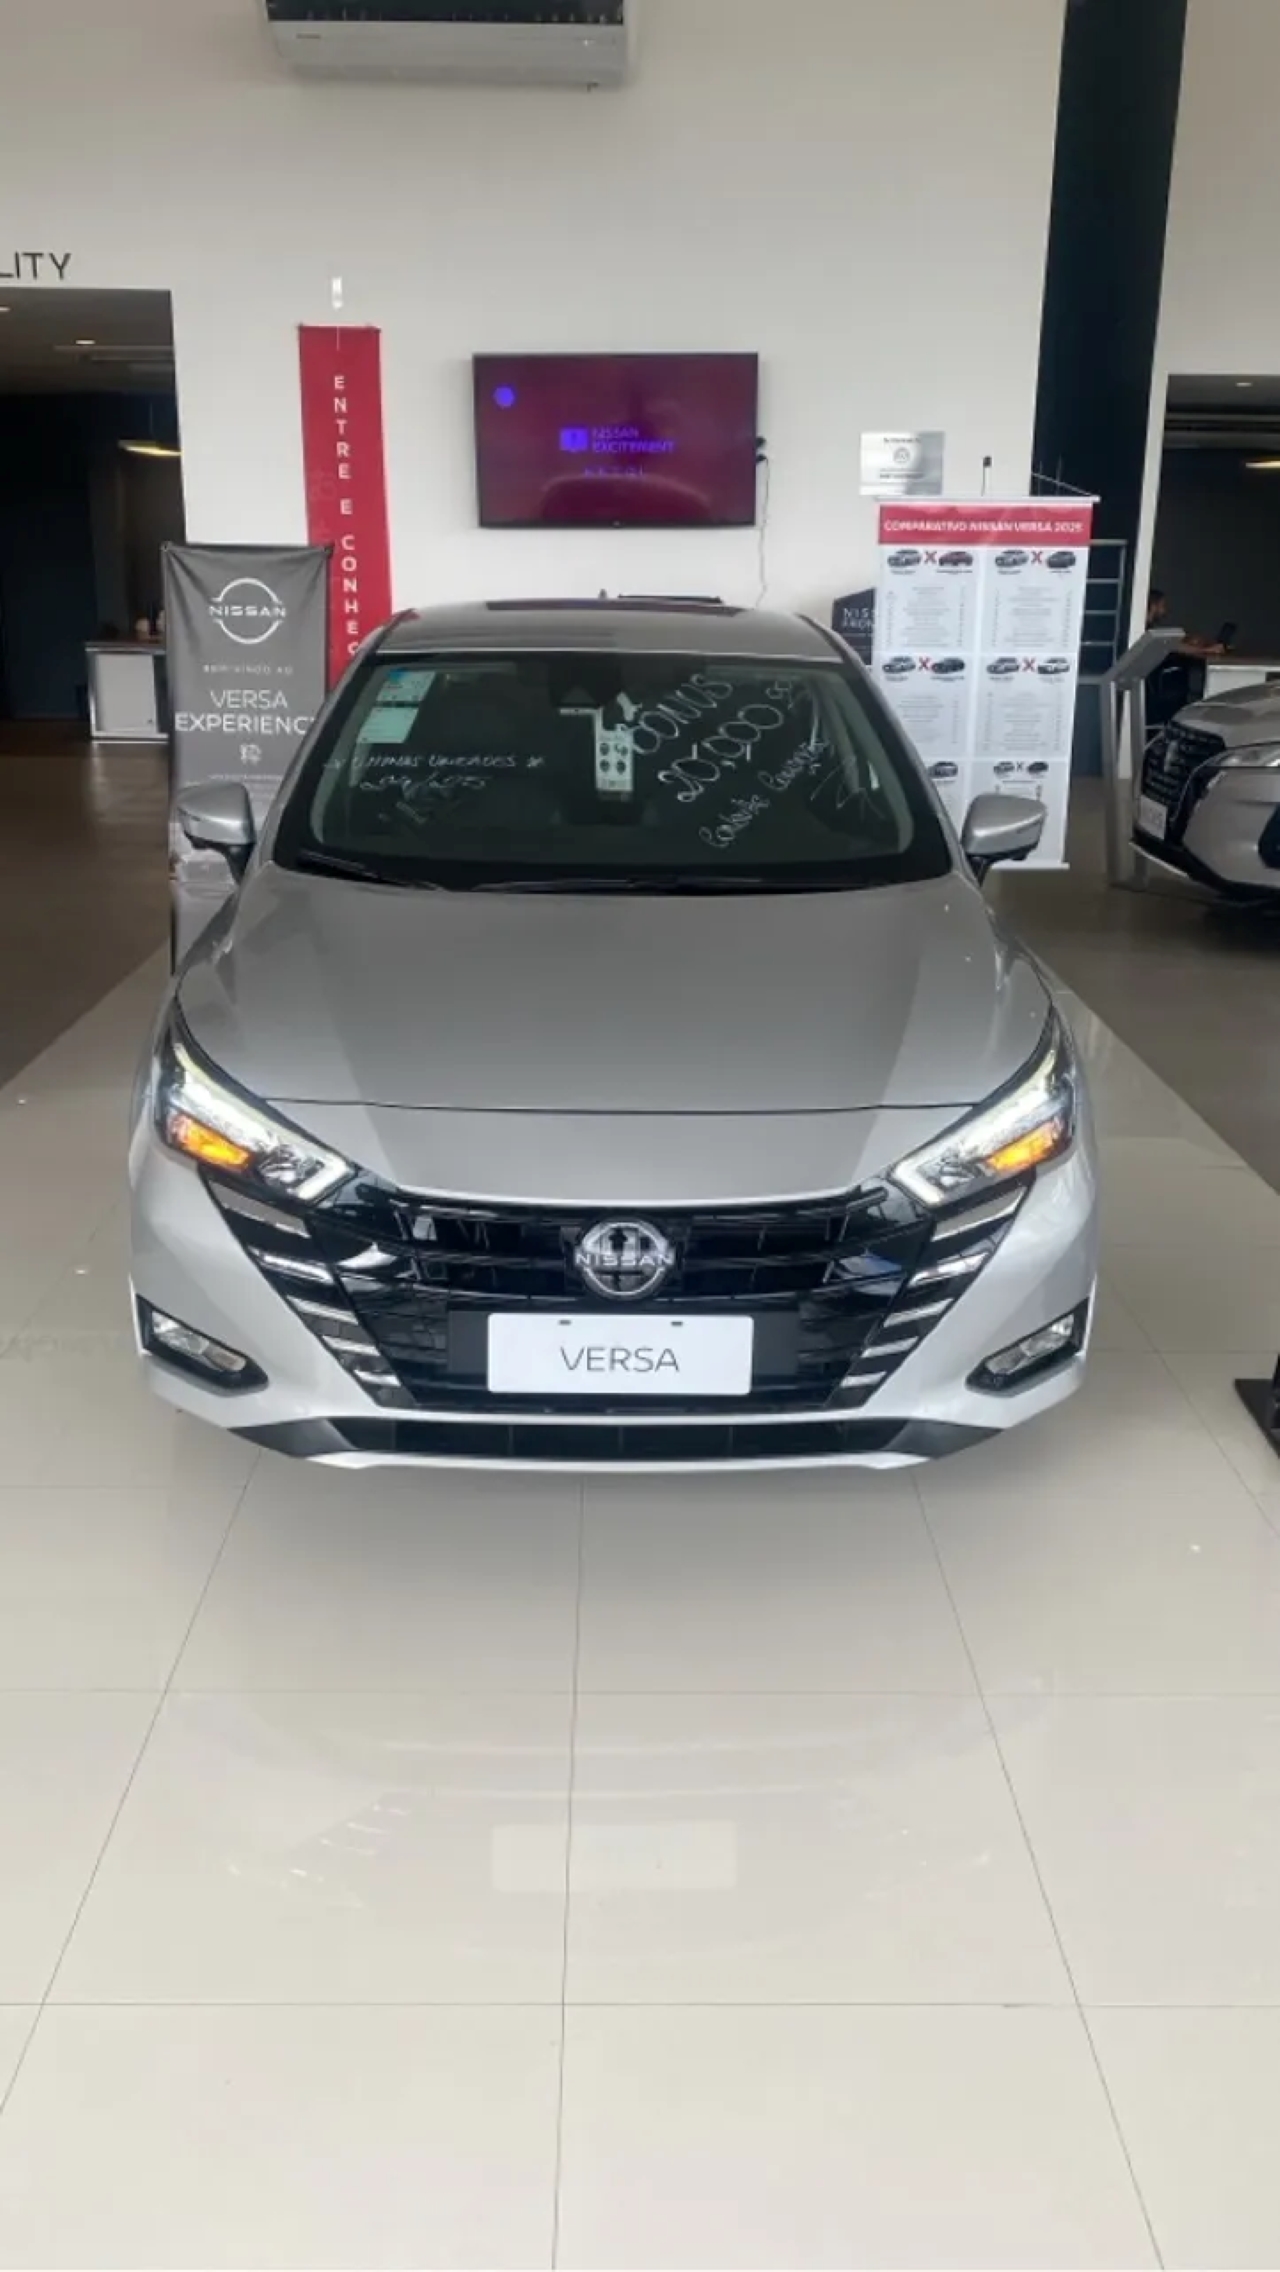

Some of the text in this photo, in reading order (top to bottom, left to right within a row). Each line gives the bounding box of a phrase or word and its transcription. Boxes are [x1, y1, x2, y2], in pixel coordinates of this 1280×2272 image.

[333, 375, 352, 480] ENTRE
[884, 519, 967, 532] COMPARATIVO
[969, 520, 1013, 532] NISSAN
[1014, 520, 1053, 533] VERSA
[208, 605, 287, 618] NISSAN
[843, 607, 876, 618] NIS
[209, 689, 288, 709] VERSA
[174, 712, 315, 735] EXPERIENC
[574, 1253, 677, 1267] NISSAN
[560, 1346, 680, 1372] VERSA
